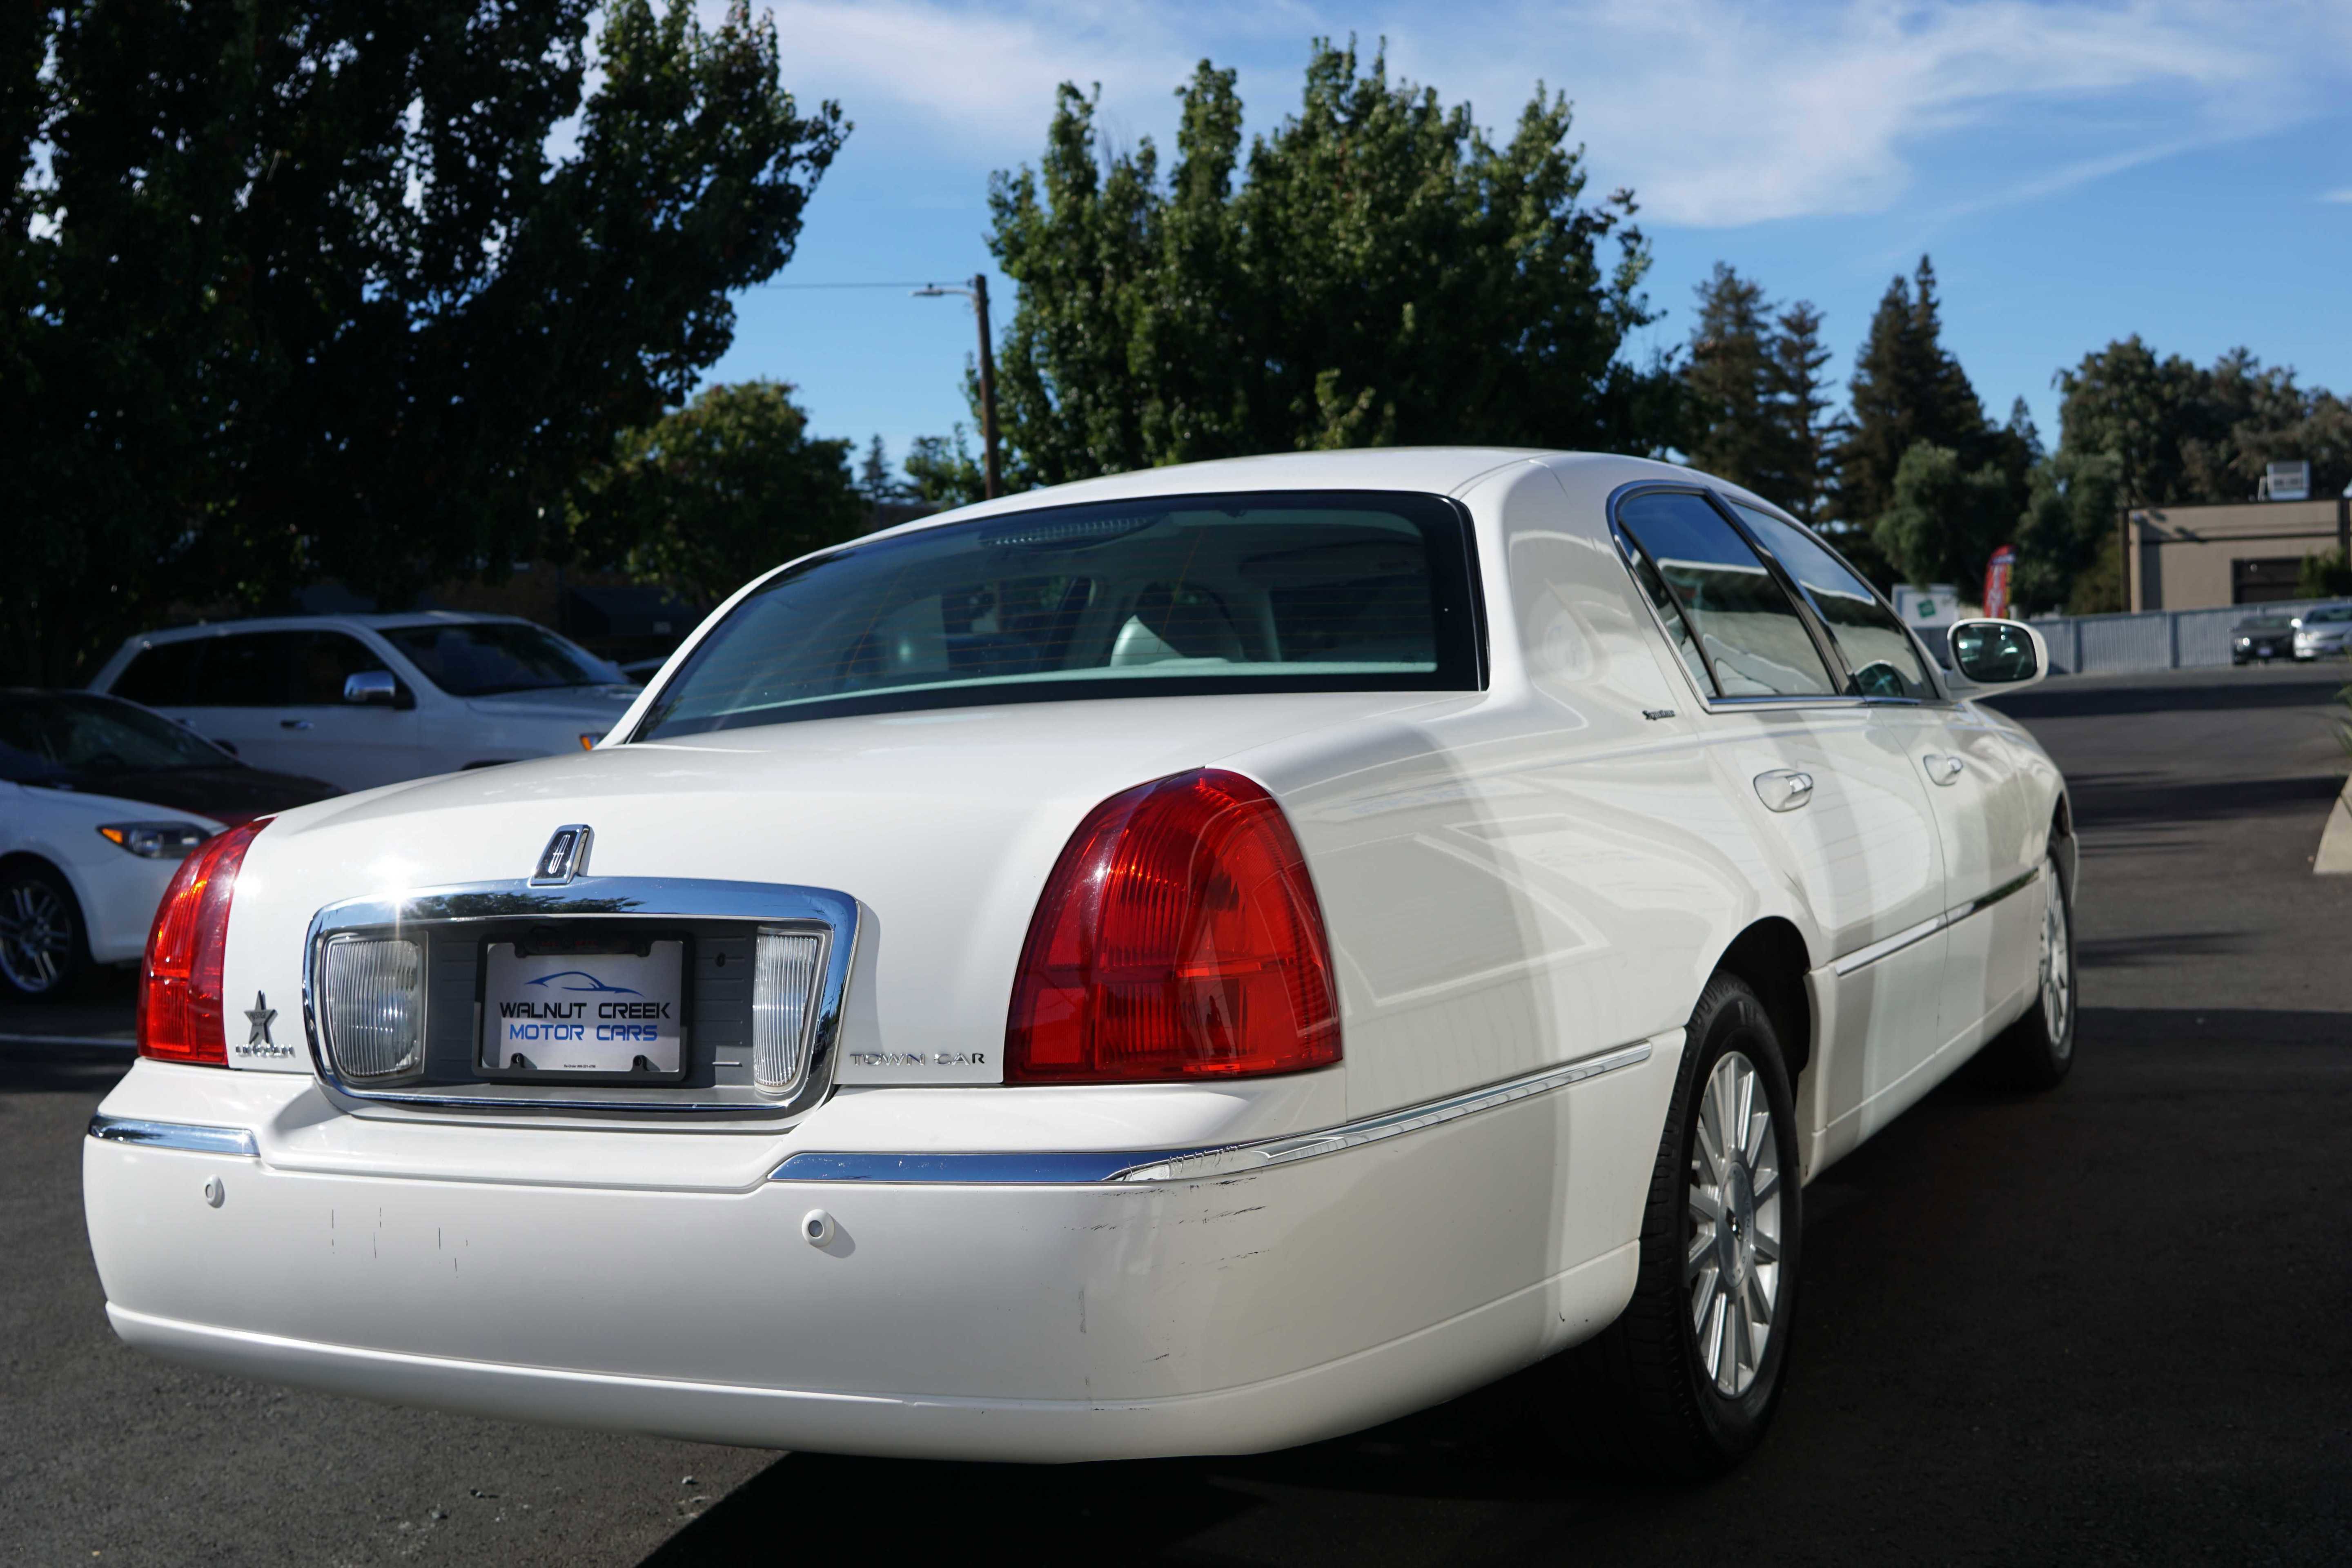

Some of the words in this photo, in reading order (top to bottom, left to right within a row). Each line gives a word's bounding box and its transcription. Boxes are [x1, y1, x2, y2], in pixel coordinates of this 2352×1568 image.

[500, 1002, 587, 1018] WALNUT
[598, 1002, 670, 1019] CREEK
[509, 1024, 584, 1040] MOTOR
[596, 1025, 657, 1041] CARS
[850, 1053, 926, 1066] TOWN
[934, 1053, 985, 1066] CAR
